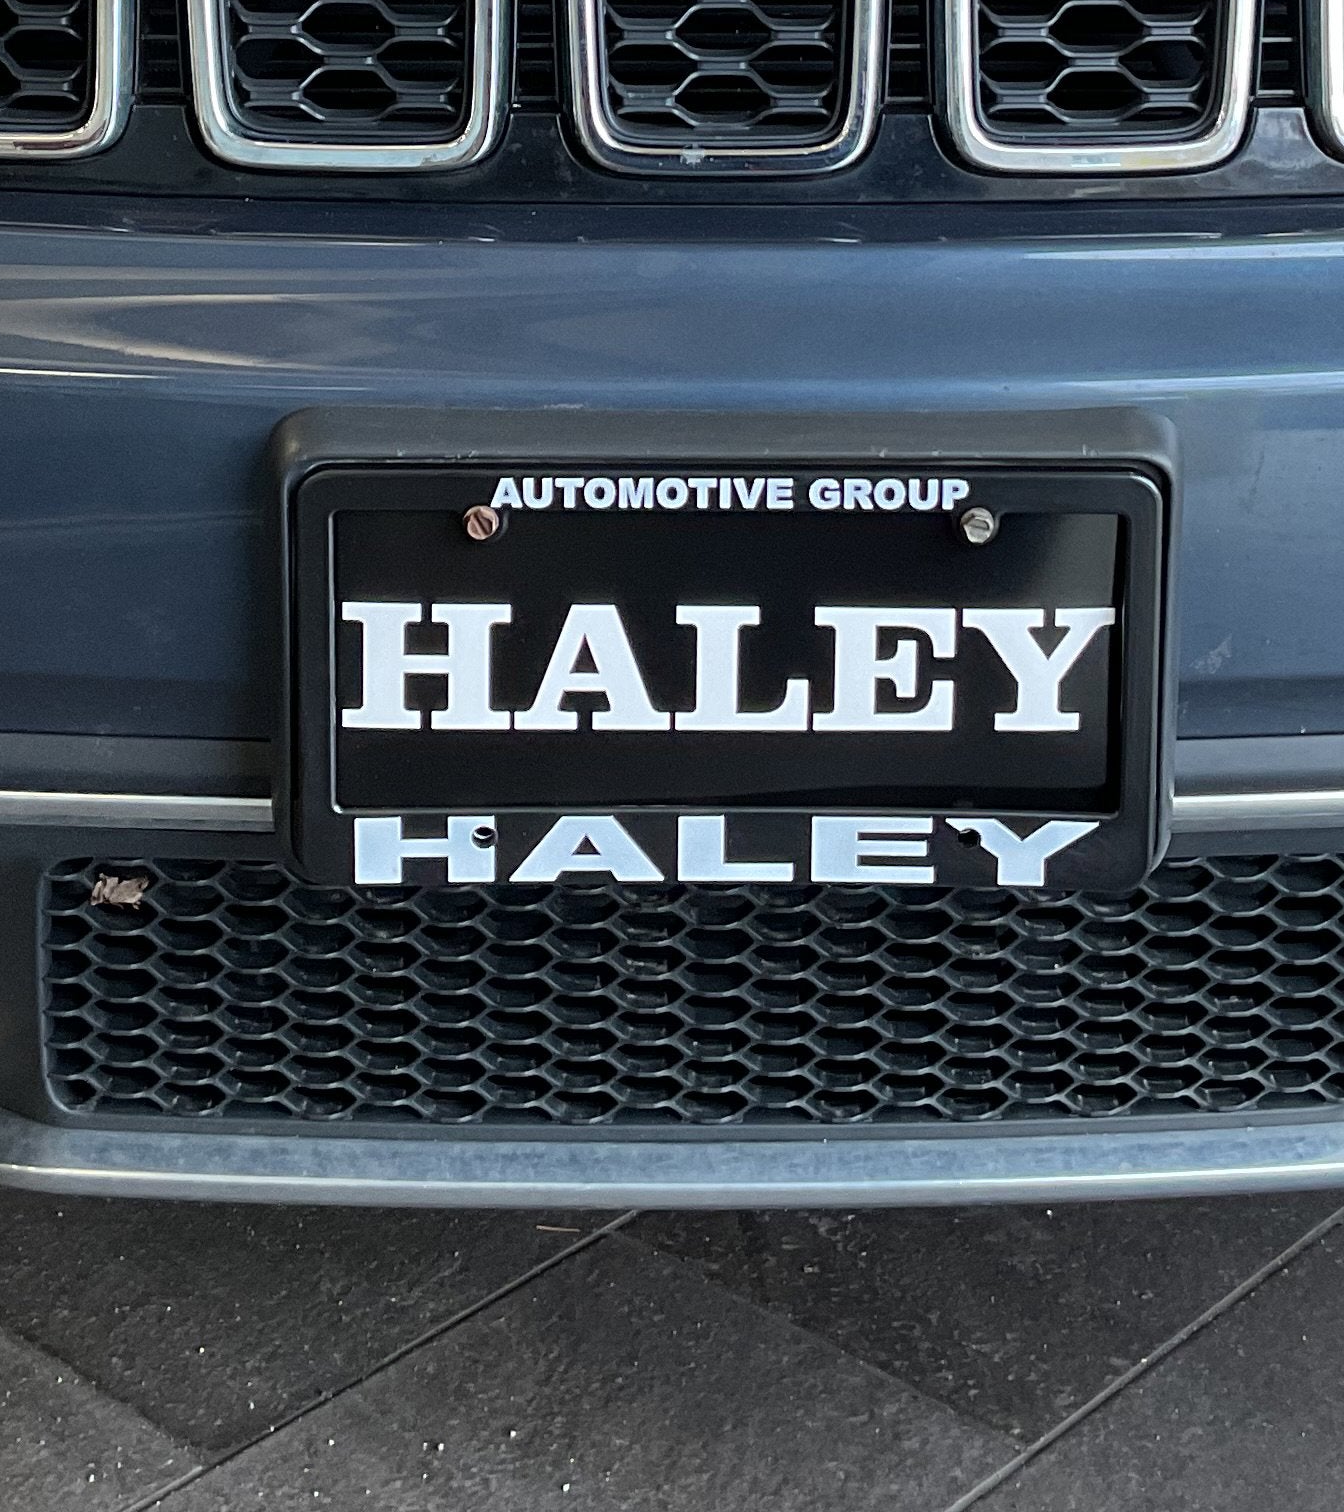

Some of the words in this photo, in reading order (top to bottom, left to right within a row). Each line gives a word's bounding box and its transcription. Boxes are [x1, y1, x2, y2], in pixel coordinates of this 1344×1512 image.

[490, 476, 794, 509] AUTOMOTIVE
[808, 477, 970, 511] GROUP
[340, 601, 1116, 732] HALEY
[353, 814, 1101, 887] HALEY
